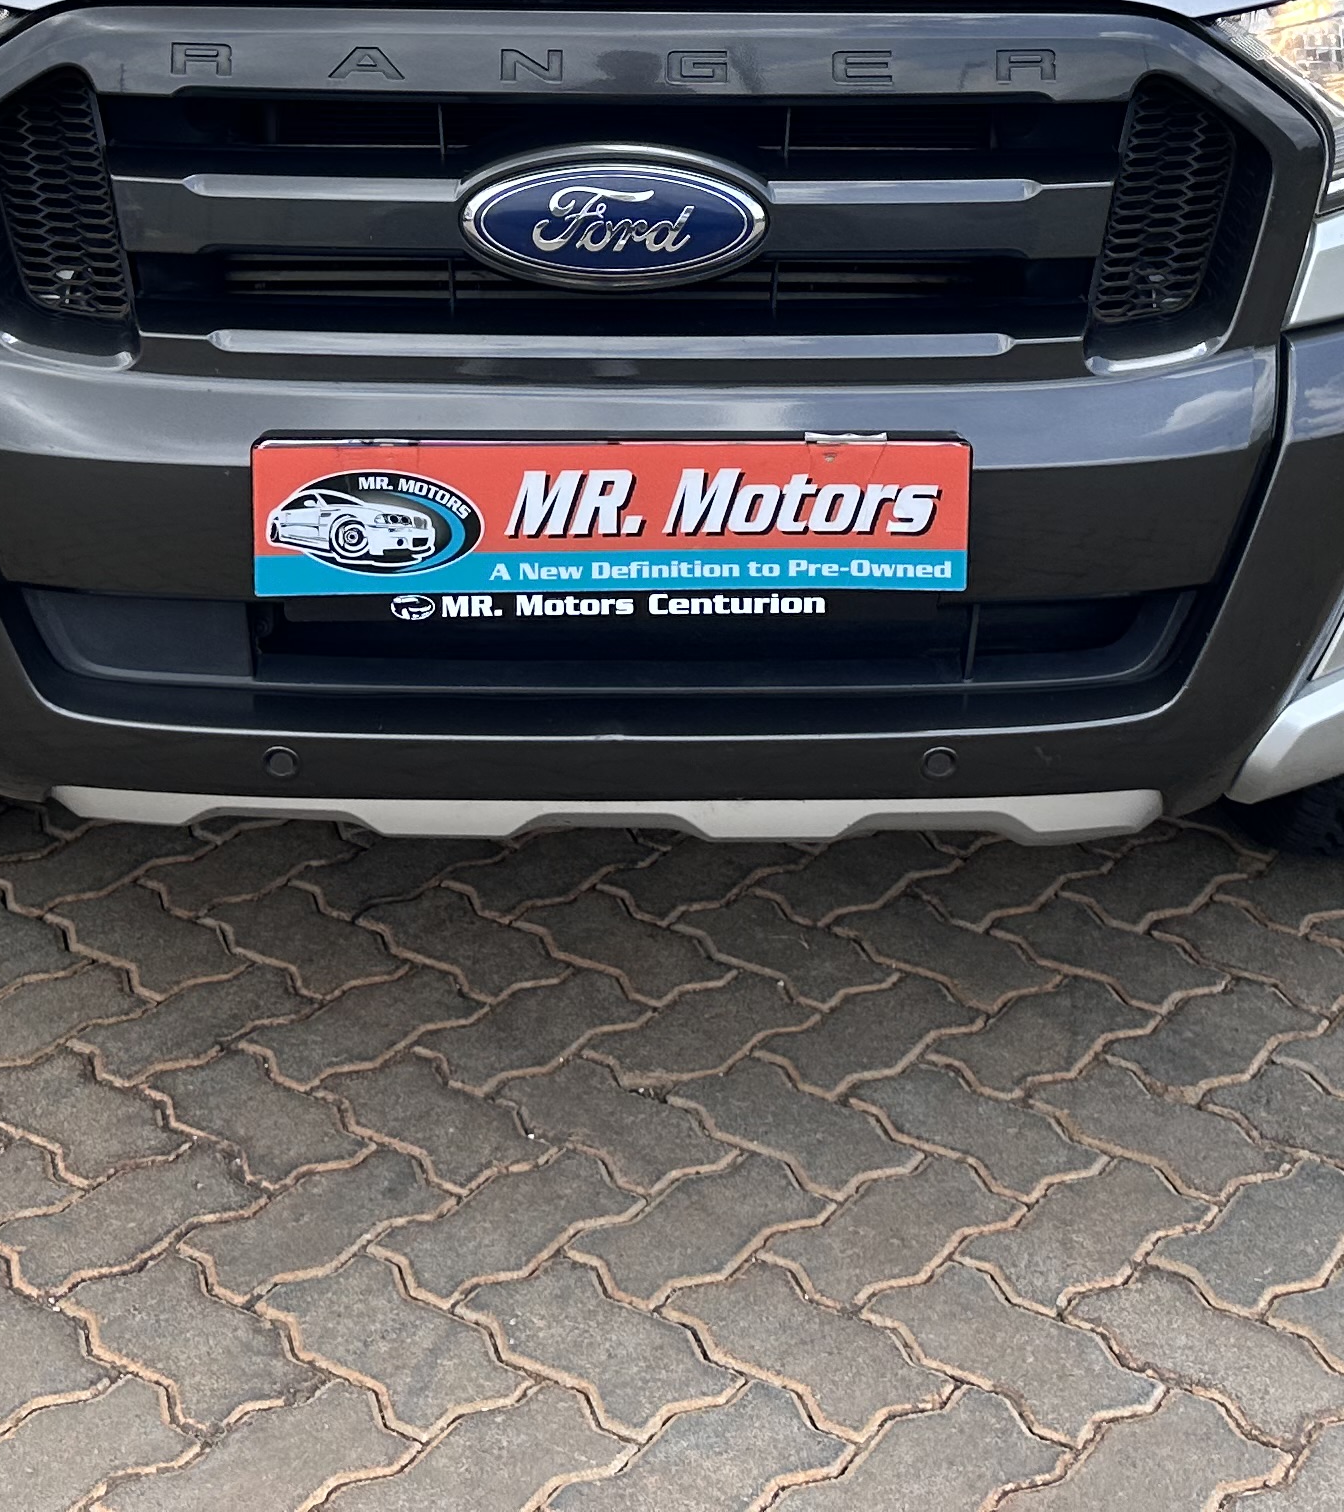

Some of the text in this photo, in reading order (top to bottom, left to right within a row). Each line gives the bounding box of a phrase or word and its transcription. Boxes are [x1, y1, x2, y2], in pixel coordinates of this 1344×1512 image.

[170, 41, 1058, 88] RANGER
[532, 186, 695, 252] Ford
[358, 476, 472, 520] MR. MOTORS
[505, 468, 941, 538] MR. Motors
[488, 559, 953, 581] A New Definition to Pre-Owned
[441, 593, 827, 618] MR. Motors Centurion
